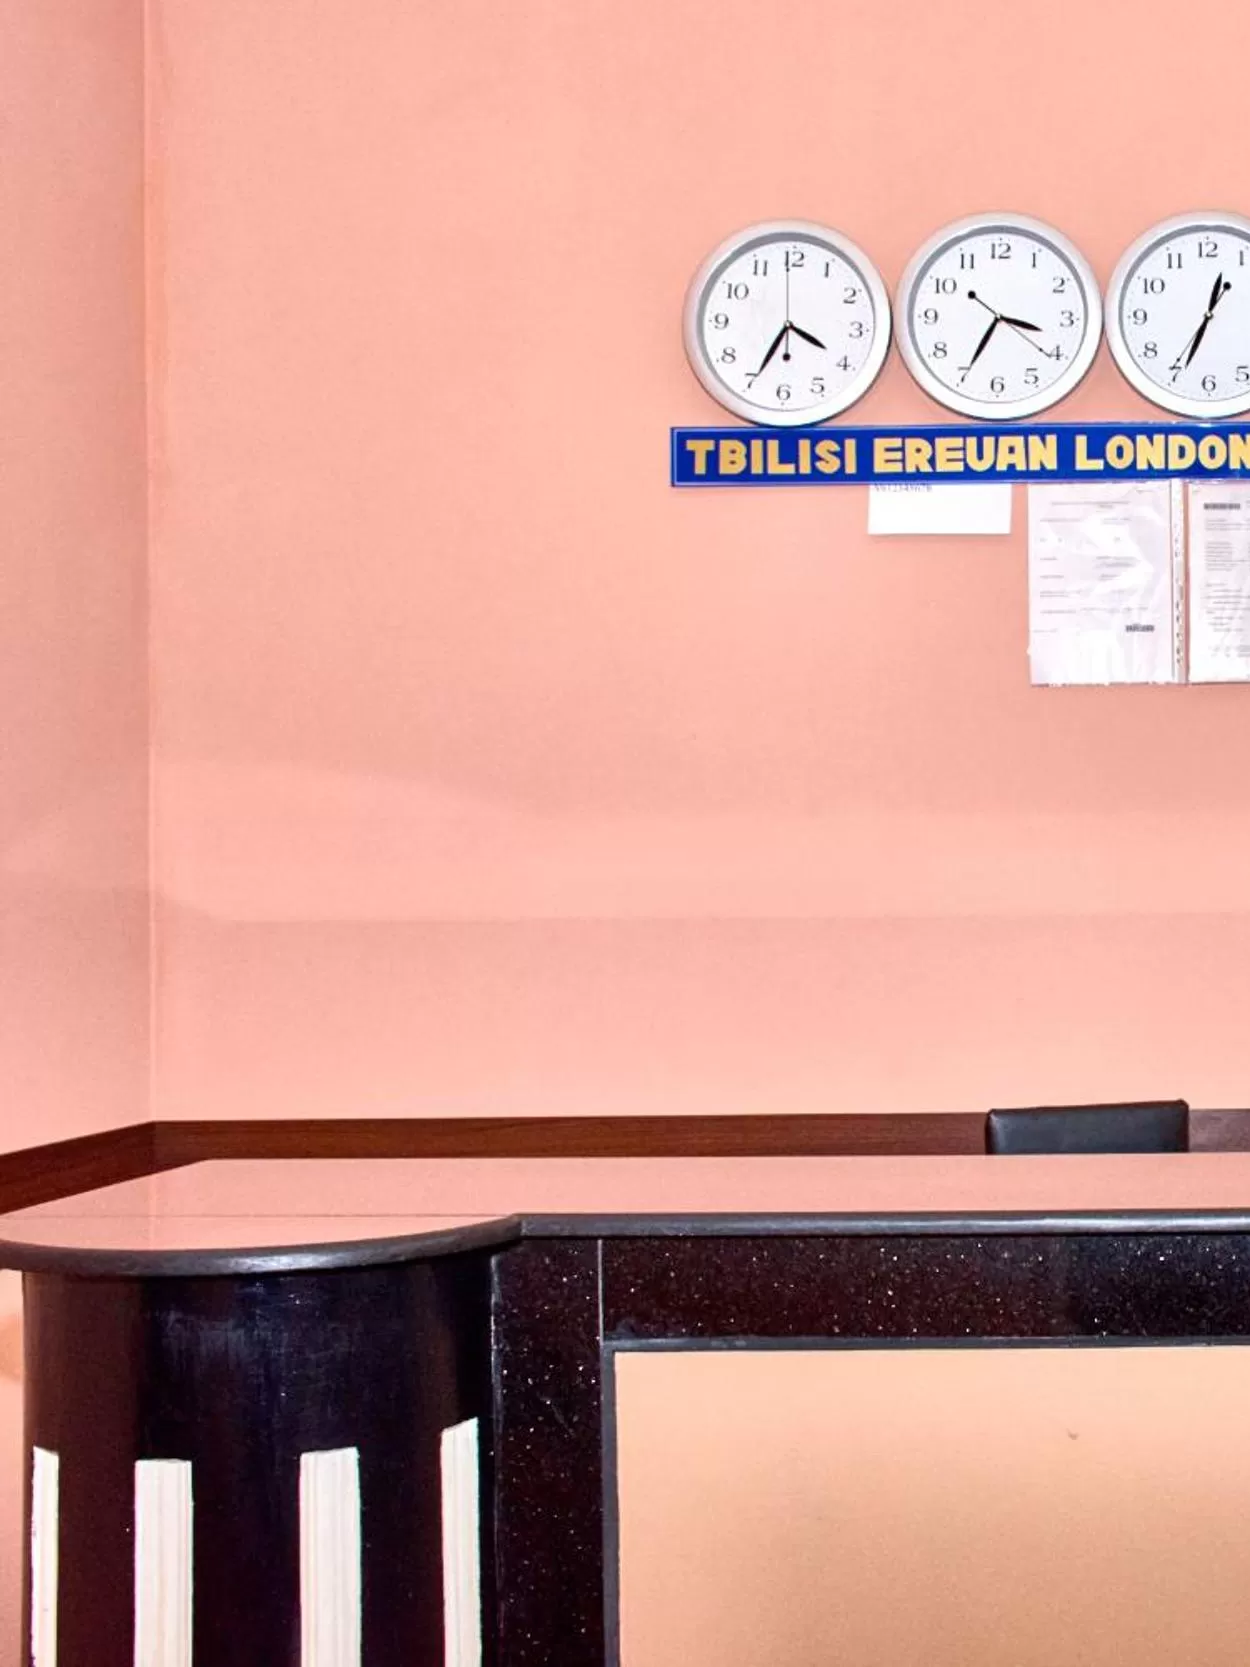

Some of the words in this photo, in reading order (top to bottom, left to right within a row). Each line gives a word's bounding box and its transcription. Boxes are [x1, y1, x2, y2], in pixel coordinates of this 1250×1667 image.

[990, 243, 1012, 260] 12
[1198, 240, 1218, 259] 12
[784, 250, 805, 270] 12
[960, 253, 975, 270] 11
[1031, 253, 1038, 268] 1
[1167, 252, 1183, 270] 11
[1238, 251, 1246, 266] 1
[753, 259, 768, 277] 11
[823, 262, 831, 277] 1
[727, 283, 750, 300] 10
[935, 277, 958, 295] 10
[1052, 277, 1066, 294] 2
[1143, 277, 1166, 295] 10
[843, 288, 857, 305] 2
[714, 313, 730, 329] 9
[923, 308, 939, 325] 9
[1059, 311, 1075, 327] 3
[1132, 309, 1148, 325] 9
[848, 322, 864, 338] 3
[720, 348, 736, 363] 8
[932, 342, 948, 358] 8
[1046, 345, 1062, 361] 4
[1143, 342, 1158, 359] 8
[837, 355, 851, 371] 4
[744, 371, 760, 390] 7
[956, 365, 971, 385] 7
[1024, 367, 1039, 385] 5
[1167, 365, 1183, 384] 7
[1235, 365, 1250, 382] 5
[775, 384, 791, 400] 6
[810, 377, 825, 395] 5
[990, 377, 1005, 393] 6
[1201, 375, 1217, 392] 6
[686, 439, 856, 474] TBILISI
